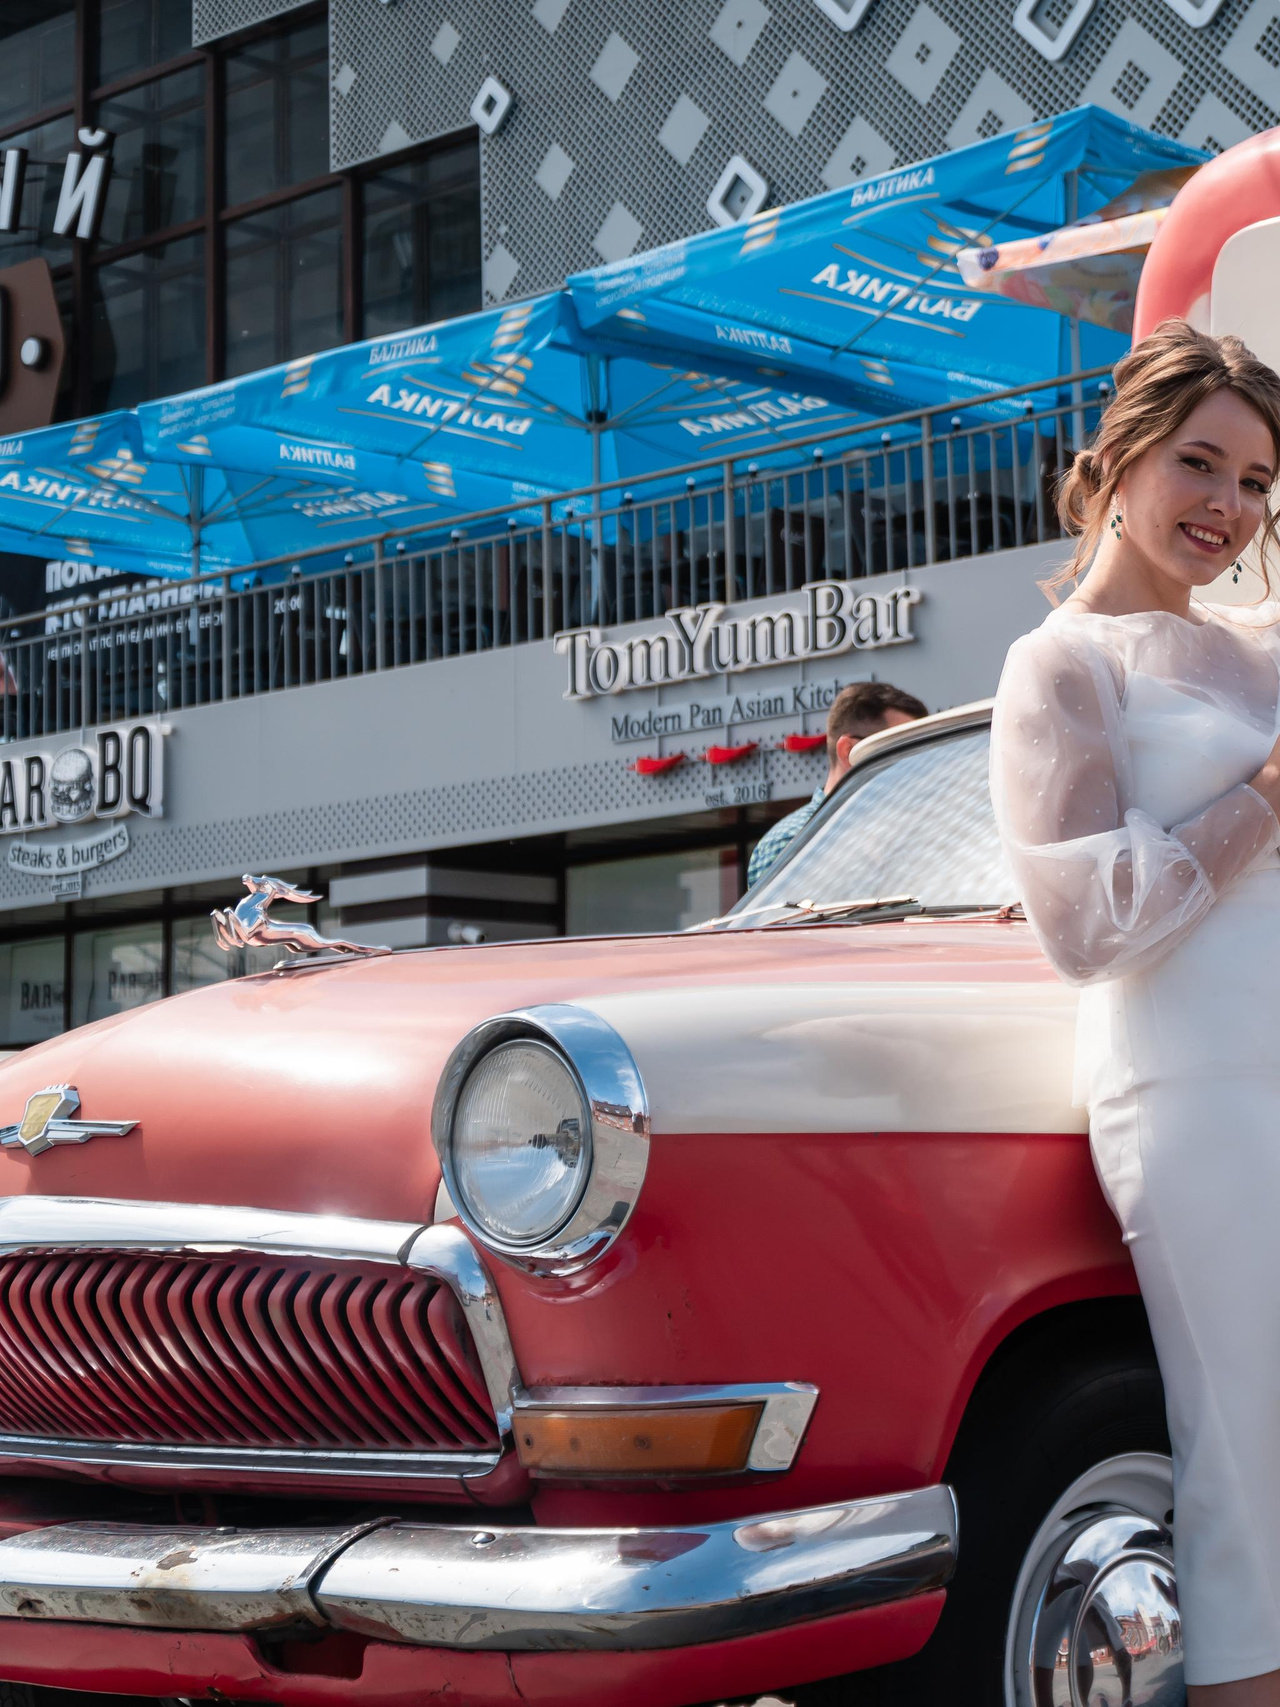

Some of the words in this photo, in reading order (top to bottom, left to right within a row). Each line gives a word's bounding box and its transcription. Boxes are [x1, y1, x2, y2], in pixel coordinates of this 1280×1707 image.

[851, 166, 936, 208] БАЛТИКА
[369, 335, 437, 365] БАЛТИКА
[554, 579, 921, 701] TomYumBar
[611, 711, 682, 742] Modern
[689, 703, 723, 729] Pan
[730, 692, 785, 722] Asian
[10, 846, 52, 868] steaks
[56, 848, 67, 867] &
[72, 830, 126, 864] burgers
